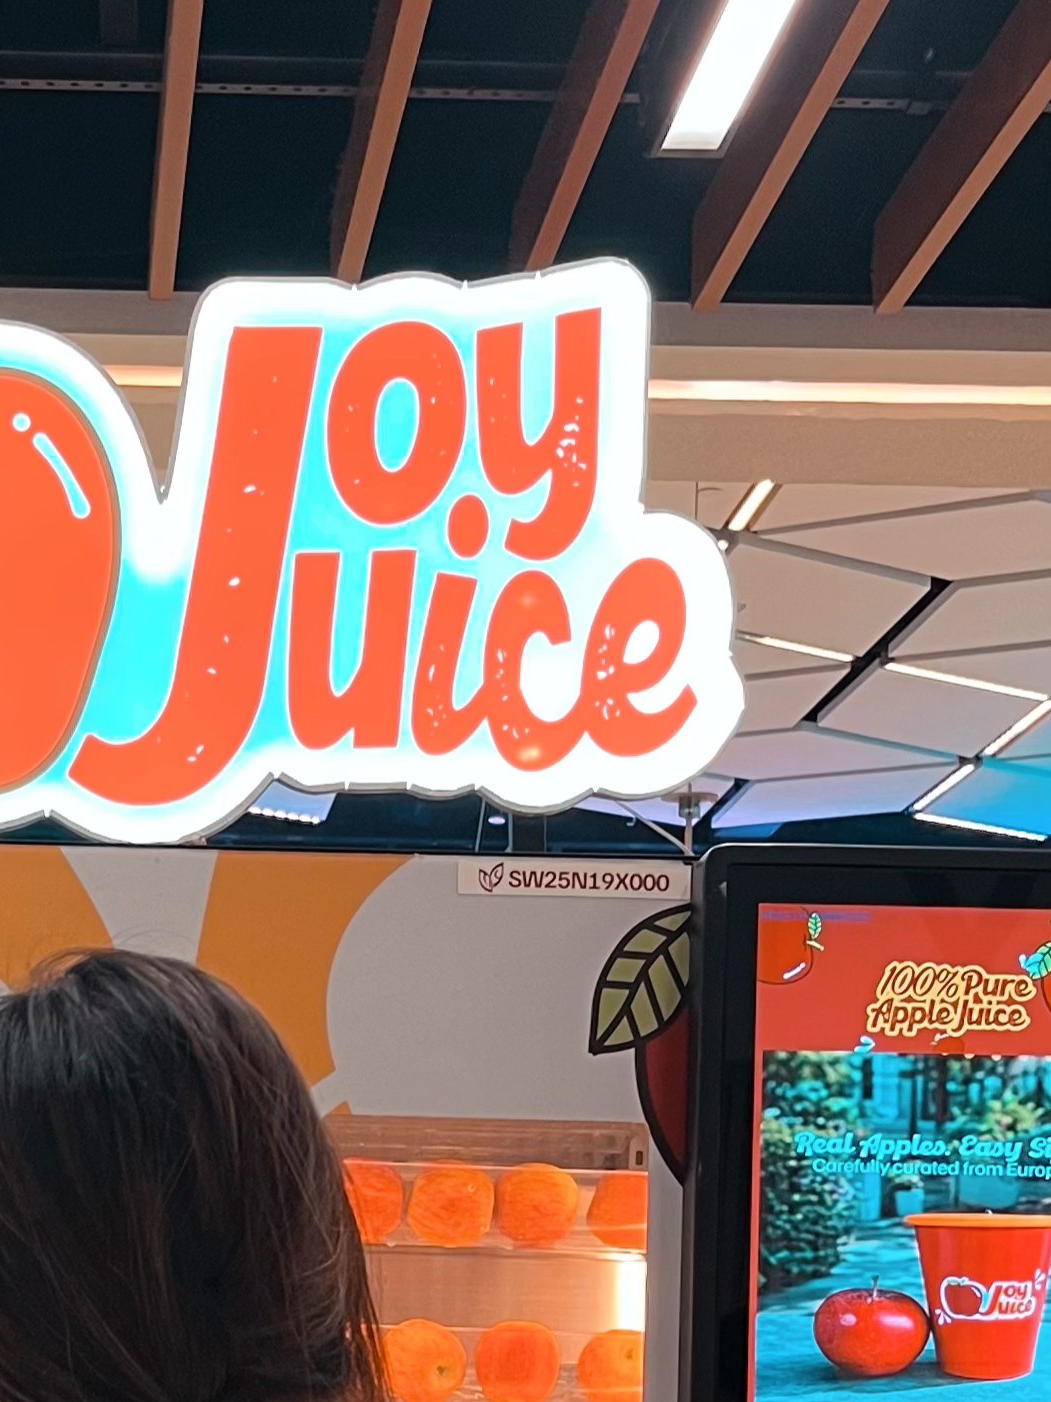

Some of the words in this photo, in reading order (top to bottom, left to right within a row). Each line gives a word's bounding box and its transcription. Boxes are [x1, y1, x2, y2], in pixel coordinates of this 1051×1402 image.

[508, 870, 670, 892] SW25N19X000
[880, 964, 960, 998] 100%
[961, 969, 1033, 998] Pure
[871, 998, 955, 1032] Apple
[952, 998, 1026, 1033] Juice
[795, 1131, 856, 1157] Real
[958, 1135, 1023, 1162] Easy
[812, 1159, 890, 1176] Carefully
[892, 1160, 960, 1176] curated
[963, 1161, 1004, 1176] from
